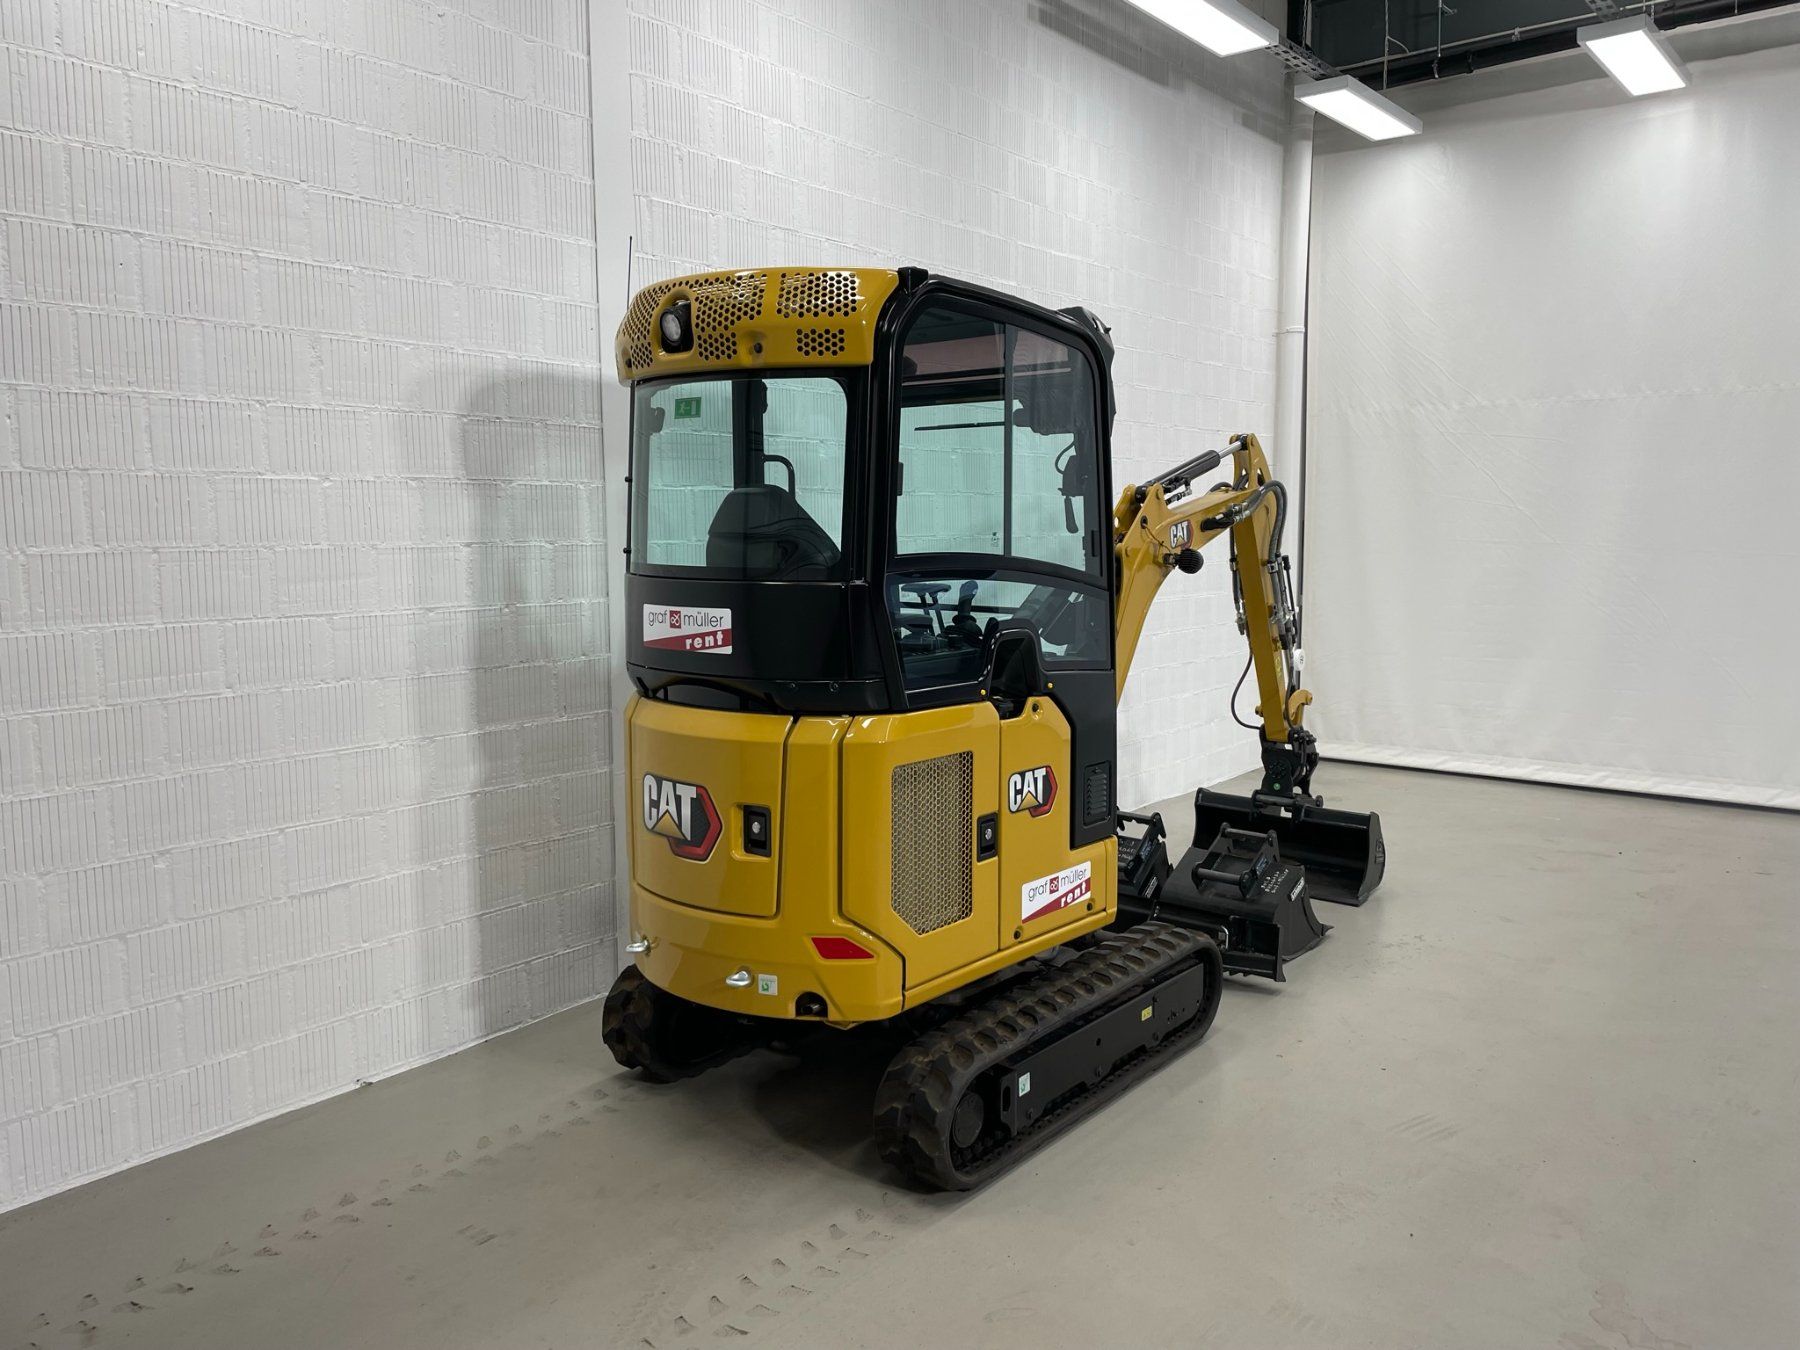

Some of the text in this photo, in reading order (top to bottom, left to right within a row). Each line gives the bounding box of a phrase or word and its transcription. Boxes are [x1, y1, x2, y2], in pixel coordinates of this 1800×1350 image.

[1171, 521, 1188, 547] CAT
[648, 609, 668, 626] graf
[683, 611, 724, 627] müller
[685, 631, 723, 650] rent
[1009, 767, 1046, 812] CAT
[643, 774, 696, 841] CAT
[1028, 880, 1048, 902] graf
[1060, 868, 1087, 887] müller
[1060, 882, 1086, 908] rent
